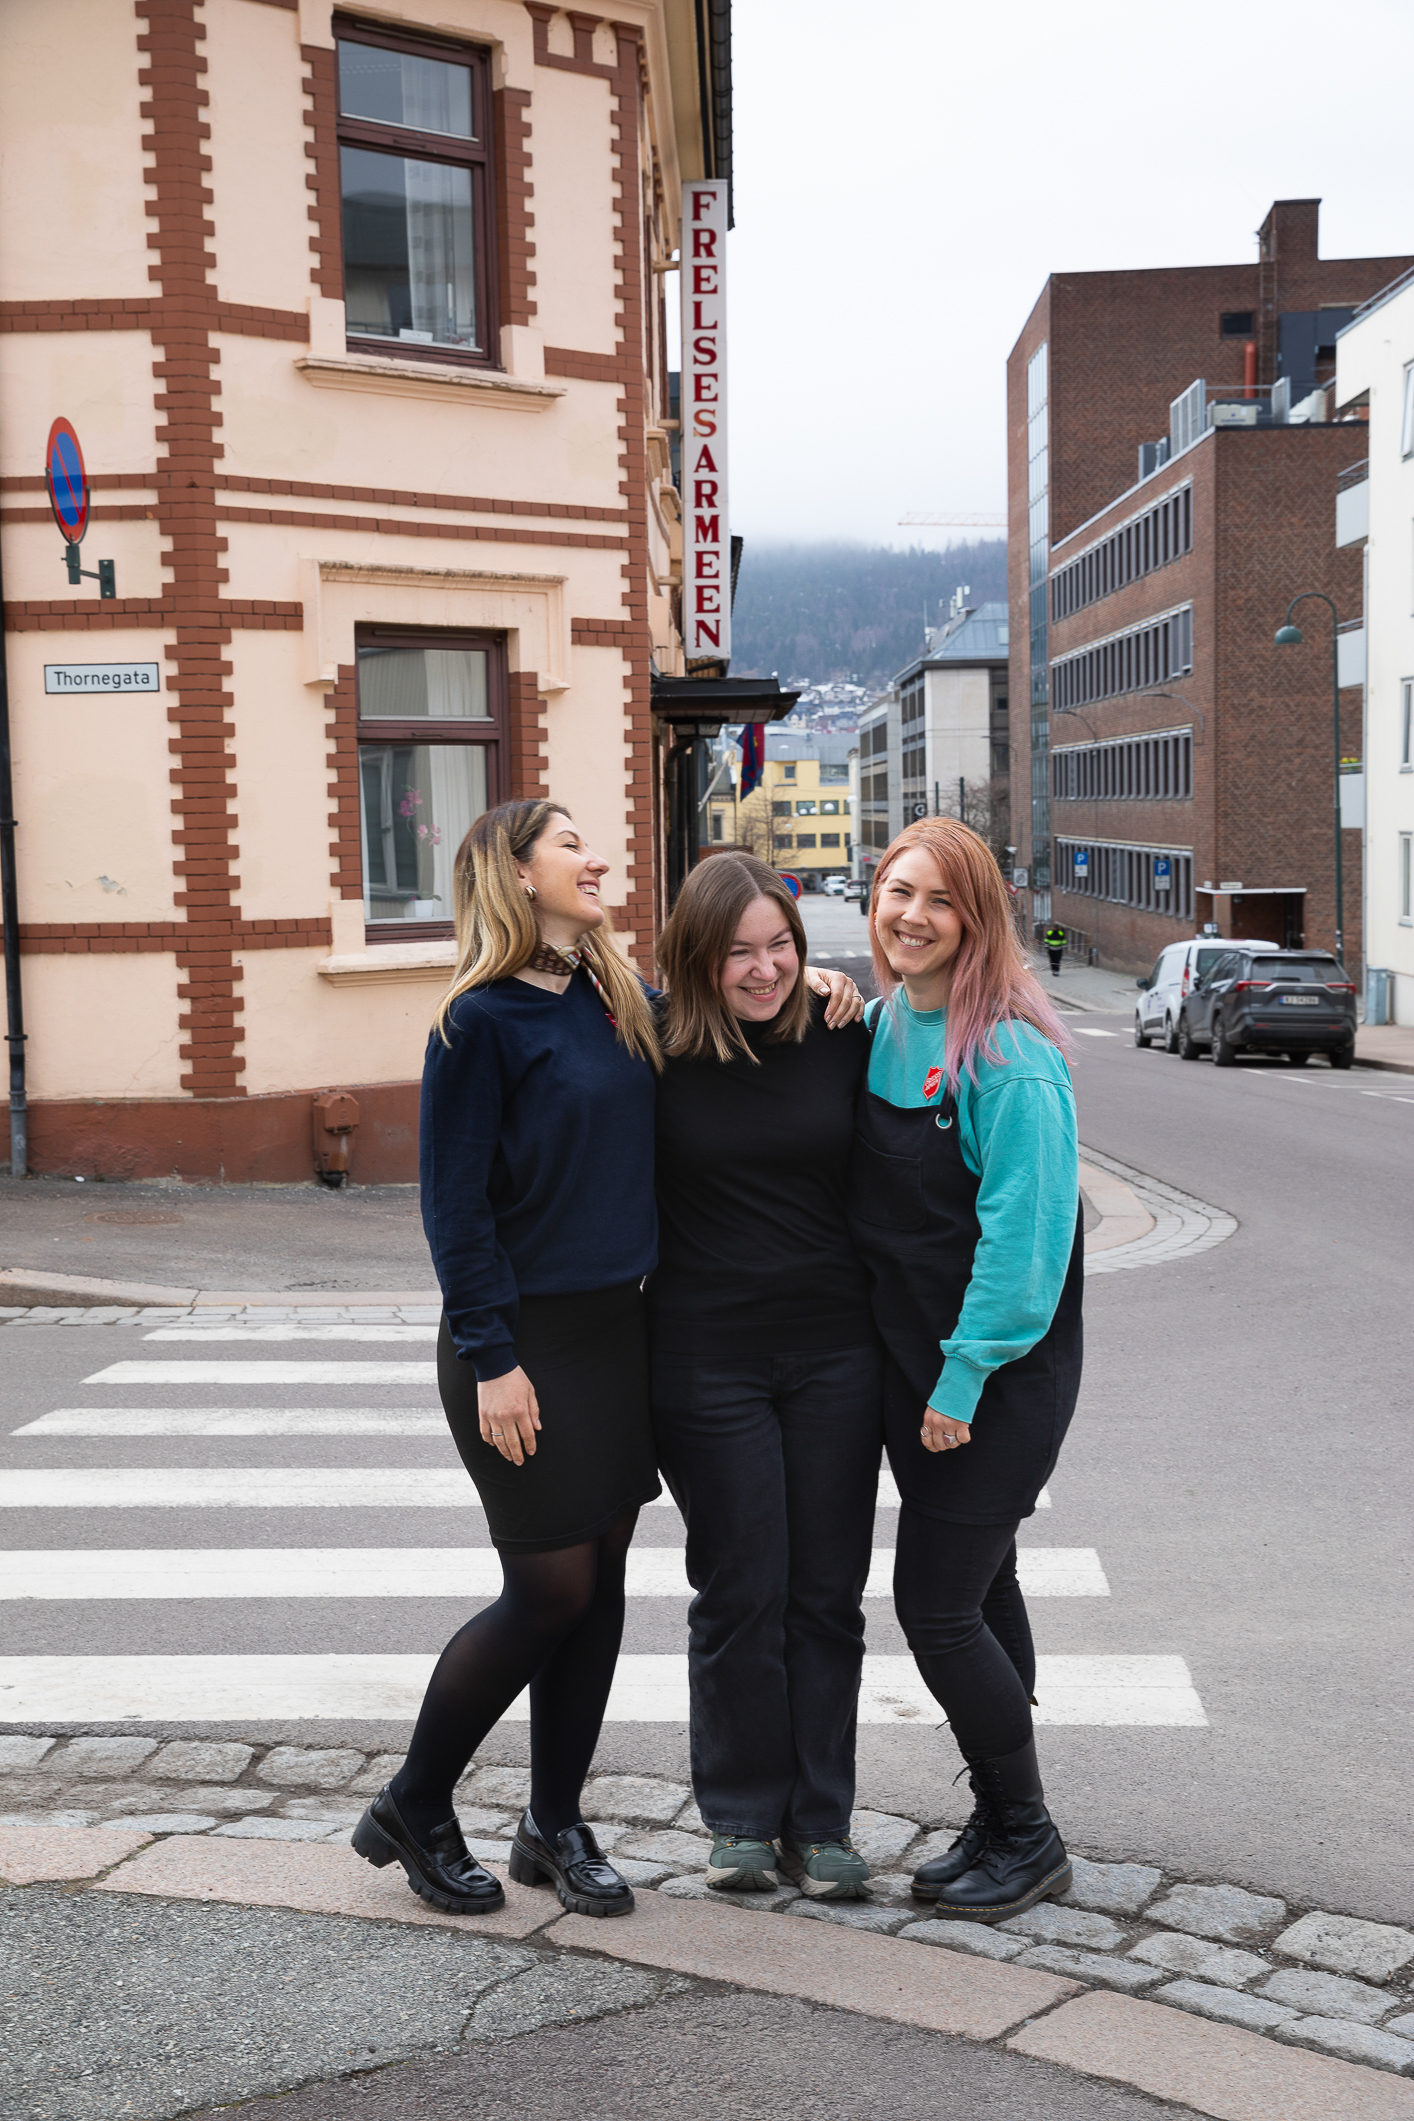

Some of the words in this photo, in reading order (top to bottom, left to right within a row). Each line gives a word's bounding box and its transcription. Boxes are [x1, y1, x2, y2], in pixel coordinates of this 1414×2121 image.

[692, 191, 721, 648] FRELSESARMEEN
[54, 671, 150, 688] Thornegata
[1157, 862, 1167, 874] P
